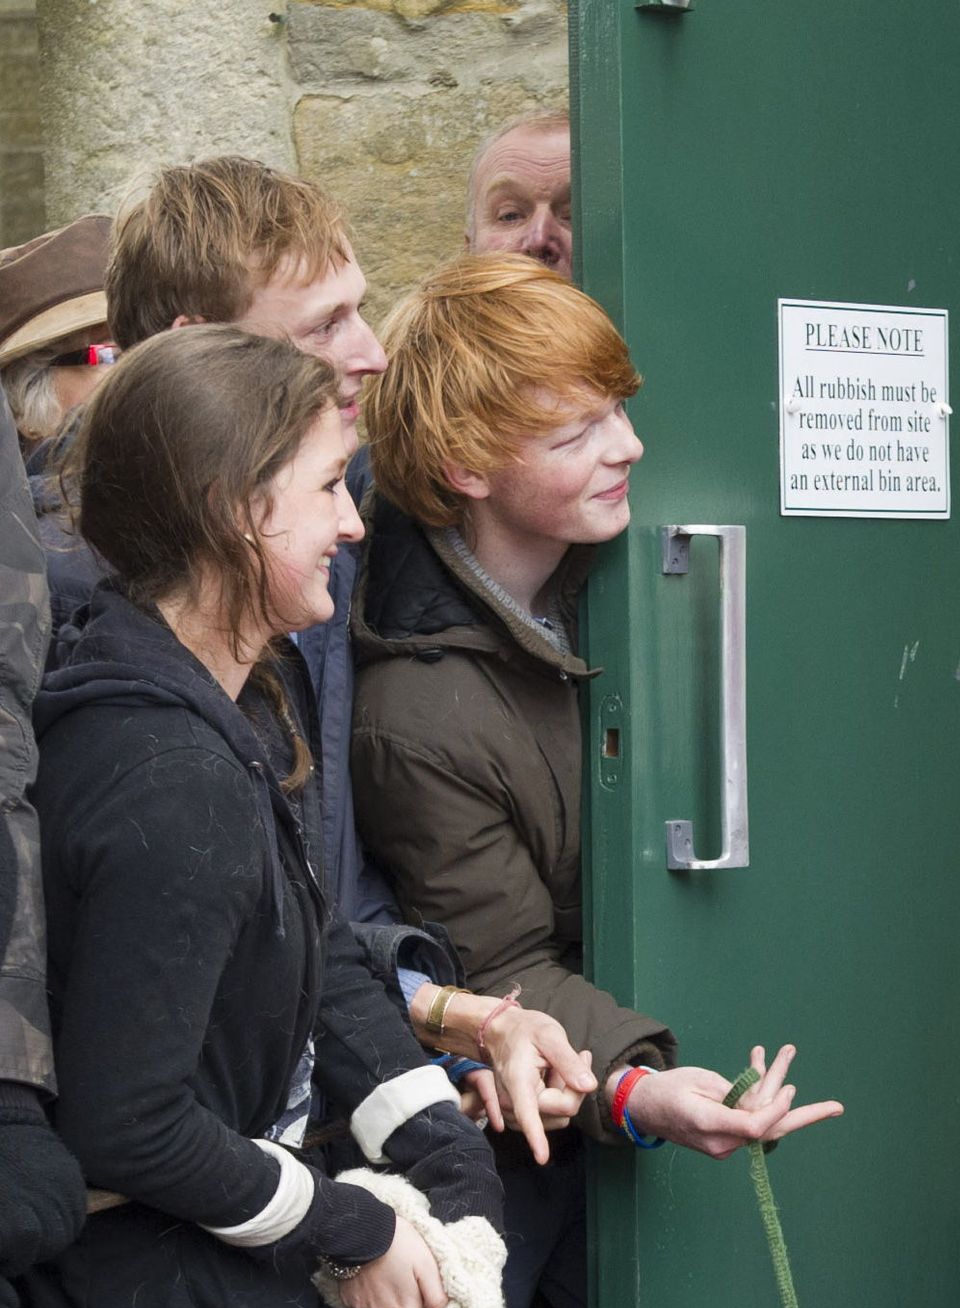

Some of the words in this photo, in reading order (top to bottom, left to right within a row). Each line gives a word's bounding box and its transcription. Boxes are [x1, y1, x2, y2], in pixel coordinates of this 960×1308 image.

[806, 323, 872, 349] PLEASE
[877, 327, 923, 352] NOTE
[793, 375, 814, 398] All
[820, 377, 876, 400] rubbish
[882, 384, 916, 402] must
[921, 381, 937, 403] be
[799, 408, 863, 430] removed
[868, 409, 902, 431] from
[907, 412, 930, 432] site
[801, 442, 816, 460] as
[822, 444, 841, 461] we
[847, 439, 864, 461] do
[869, 444, 892, 461] not
[897, 440, 929, 462] have
[791, 473, 808, 490] an
[814, 469, 873, 491] external
[879, 470, 901, 491] bin
[906, 476, 940, 492] area.
